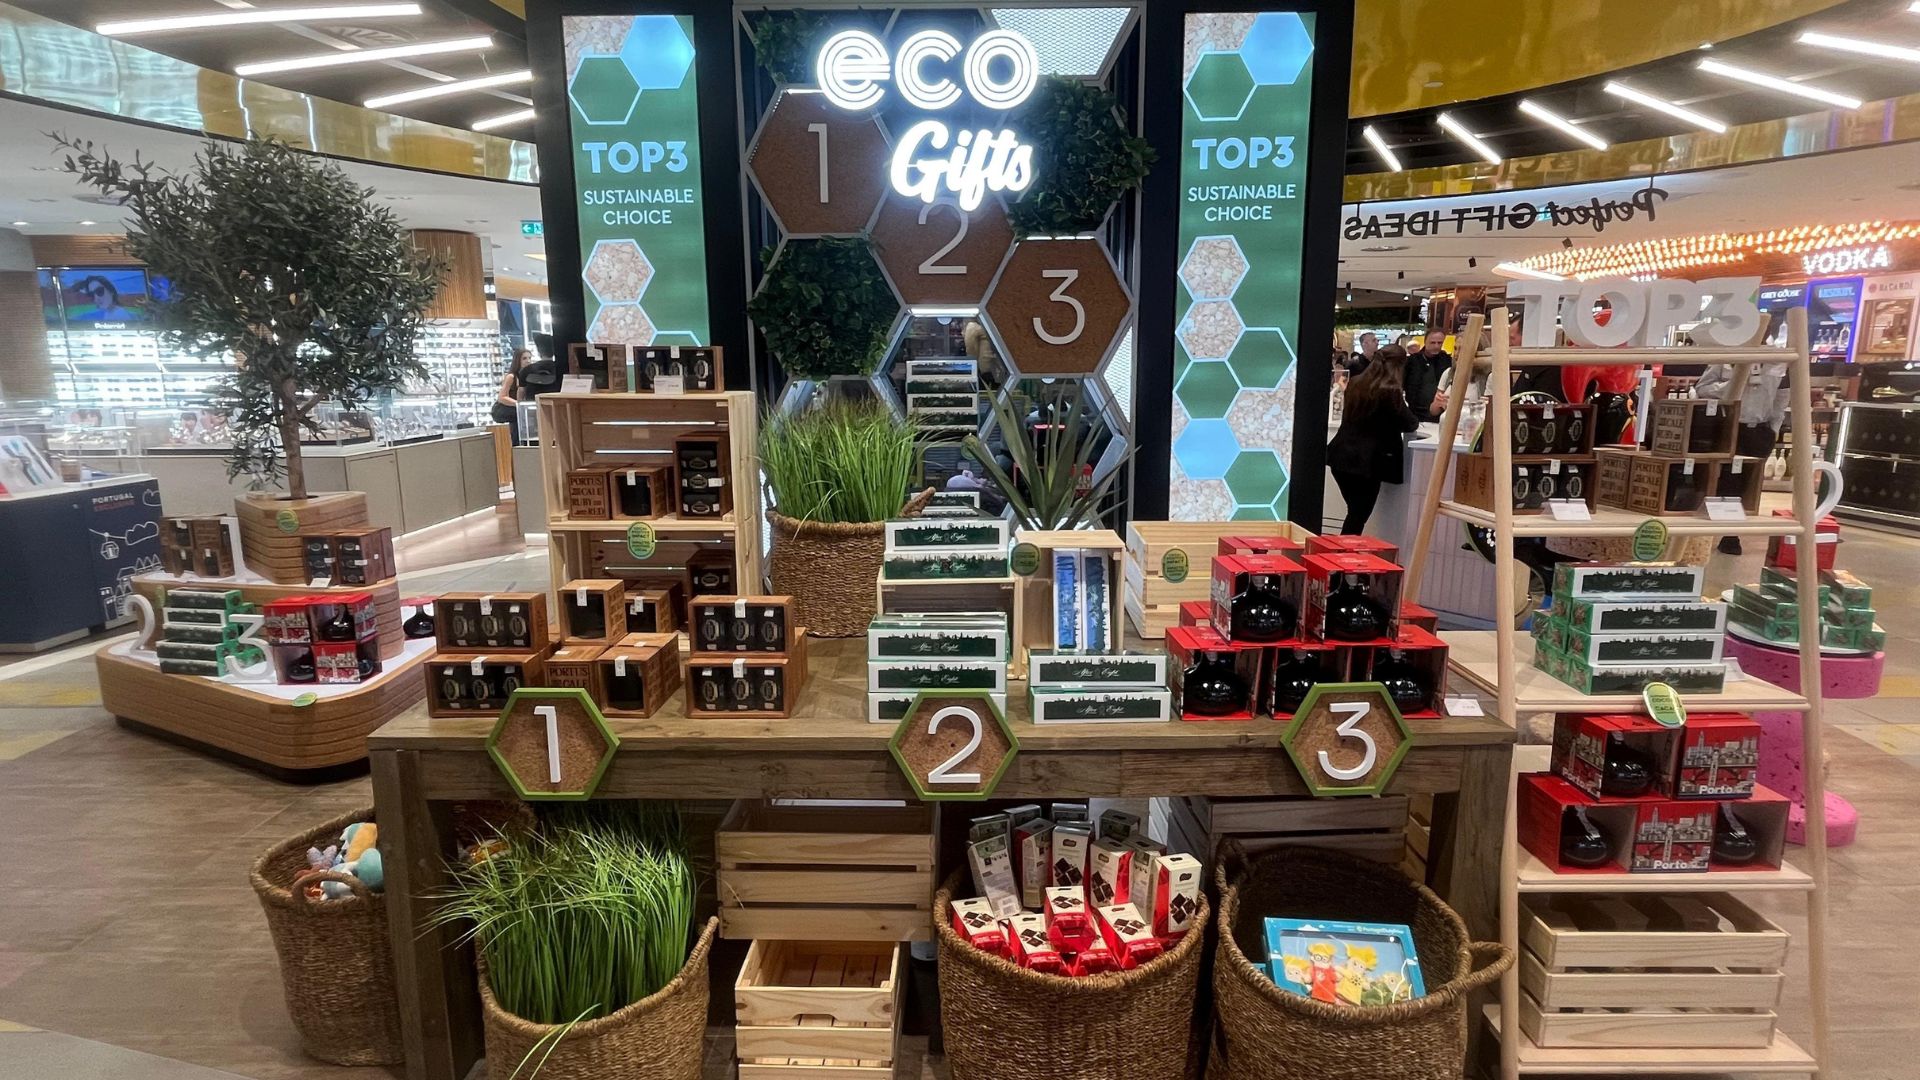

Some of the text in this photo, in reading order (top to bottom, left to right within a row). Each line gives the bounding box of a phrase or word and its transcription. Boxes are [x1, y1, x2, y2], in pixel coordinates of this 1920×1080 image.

[817, 30, 1039, 110] eco
[582, 141, 688, 174] TOP3
[808, 123, 829, 204] 1
[890, 120, 1033, 211] Gifts
[1191, 136, 1295, 170] TOP3
[583, 189, 694, 206] SUSTAINABLE
[603, 209, 672, 225] CHOICE
[1188, 184, 1296, 202] SUSTAINABLE
[1204, 205, 1272, 222] CHOICE
[918, 199, 968, 275] 2
[1803, 245, 1890, 275] VODKA
[1033, 269, 1086, 345] 3
[1506, 276, 1763, 348] TOP3
[225, 614, 276, 682] 3
[533, 705, 562, 783] 1
[928, 706, 982, 783] 2
[1318, 702, 1376, 780] 3
[1699, 785, 1733, 795] Porto
[1653, 860, 1688, 870] Porto
